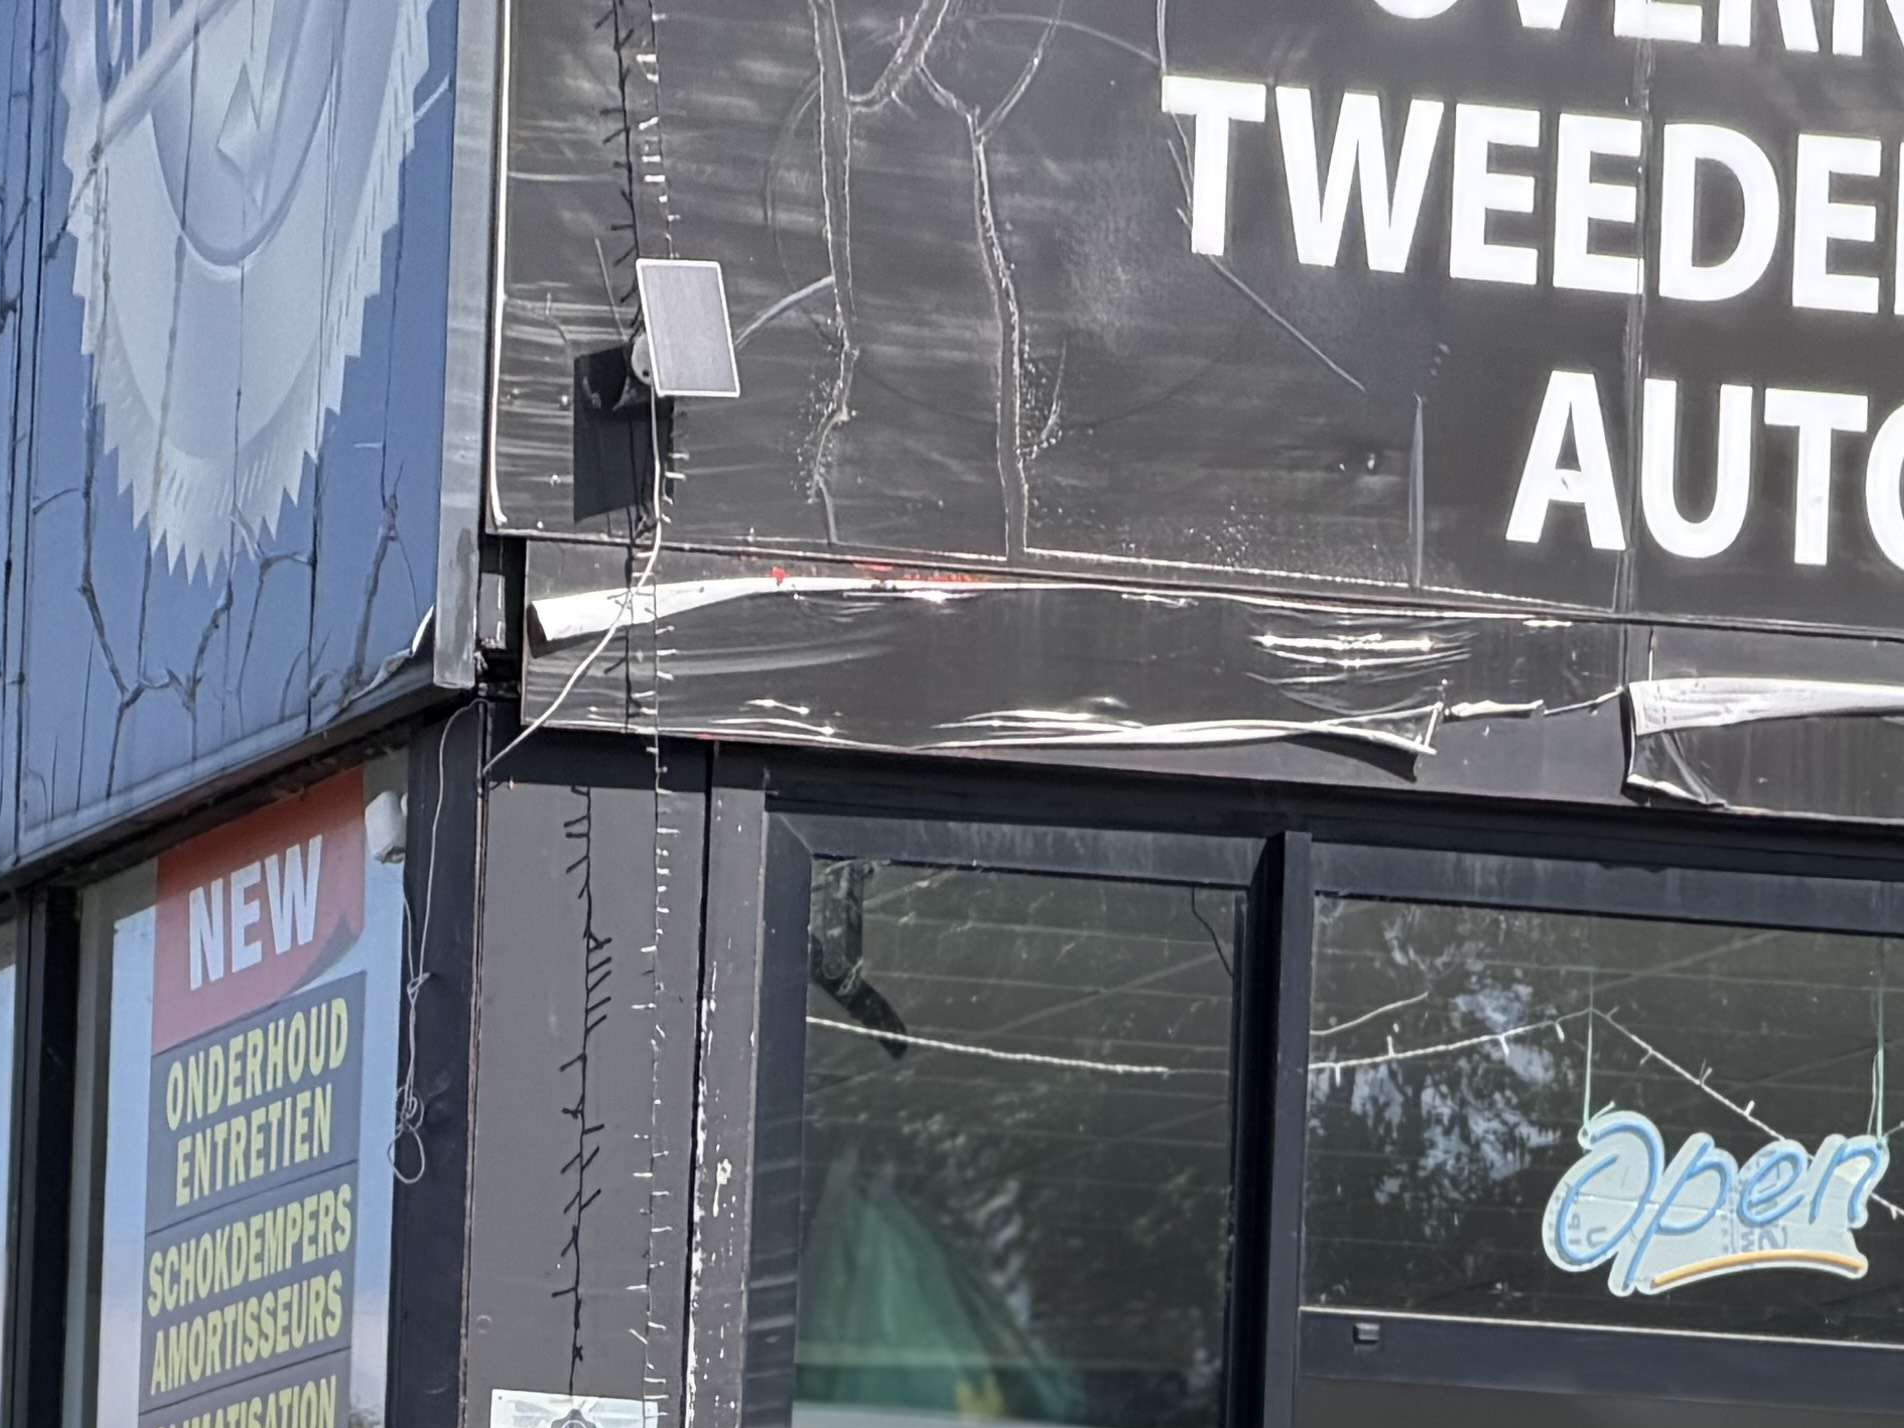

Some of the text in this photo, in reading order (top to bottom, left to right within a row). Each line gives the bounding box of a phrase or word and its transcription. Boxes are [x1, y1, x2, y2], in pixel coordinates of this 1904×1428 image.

[189, 835, 324, 991] NEW
[166, 997, 349, 1132] ONDERHOUD
[175, 1083, 333, 1208] ENTRETIEN
[1557, 1120, 1885, 1291] Open
[147, 1185, 352, 1317] SCHOKDEMPERS
[150, 1270, 343, 1396] AMORTISSEURS
